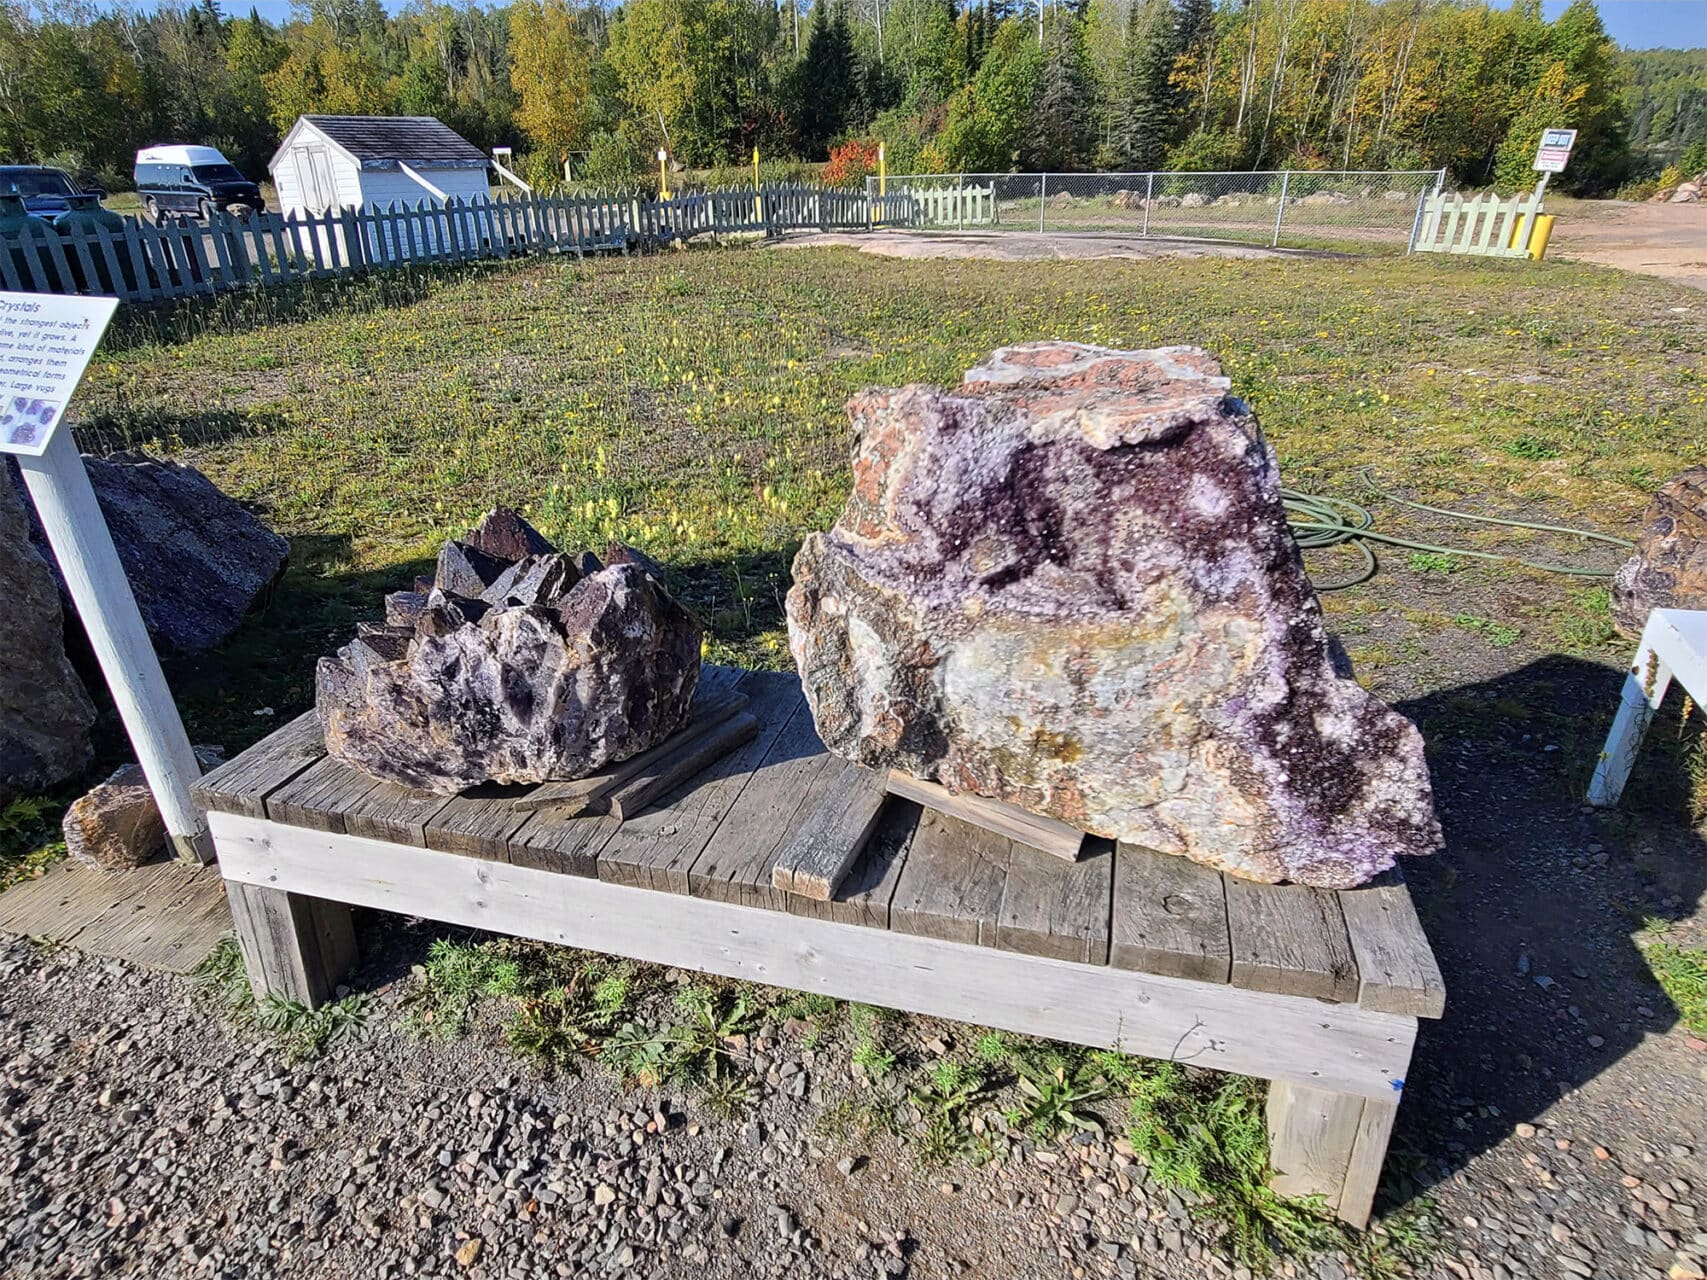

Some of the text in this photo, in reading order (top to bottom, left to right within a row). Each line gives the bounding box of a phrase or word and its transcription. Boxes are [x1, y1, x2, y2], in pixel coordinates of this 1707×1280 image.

[20, 318, 58, 329] strangest
[59, 321, 90, 330] objects
[17, 343, 35, 352] kind
[37, 344, 45, 352] of
[48, 346, 86, 356] materials
[8, 355, 43, 366] arranges
[46, 357, 68, 367] them
[42, 370, 66, 380] forms
[10, 381, 33, 392] Large
[36, 384, 56, 394] vugs
